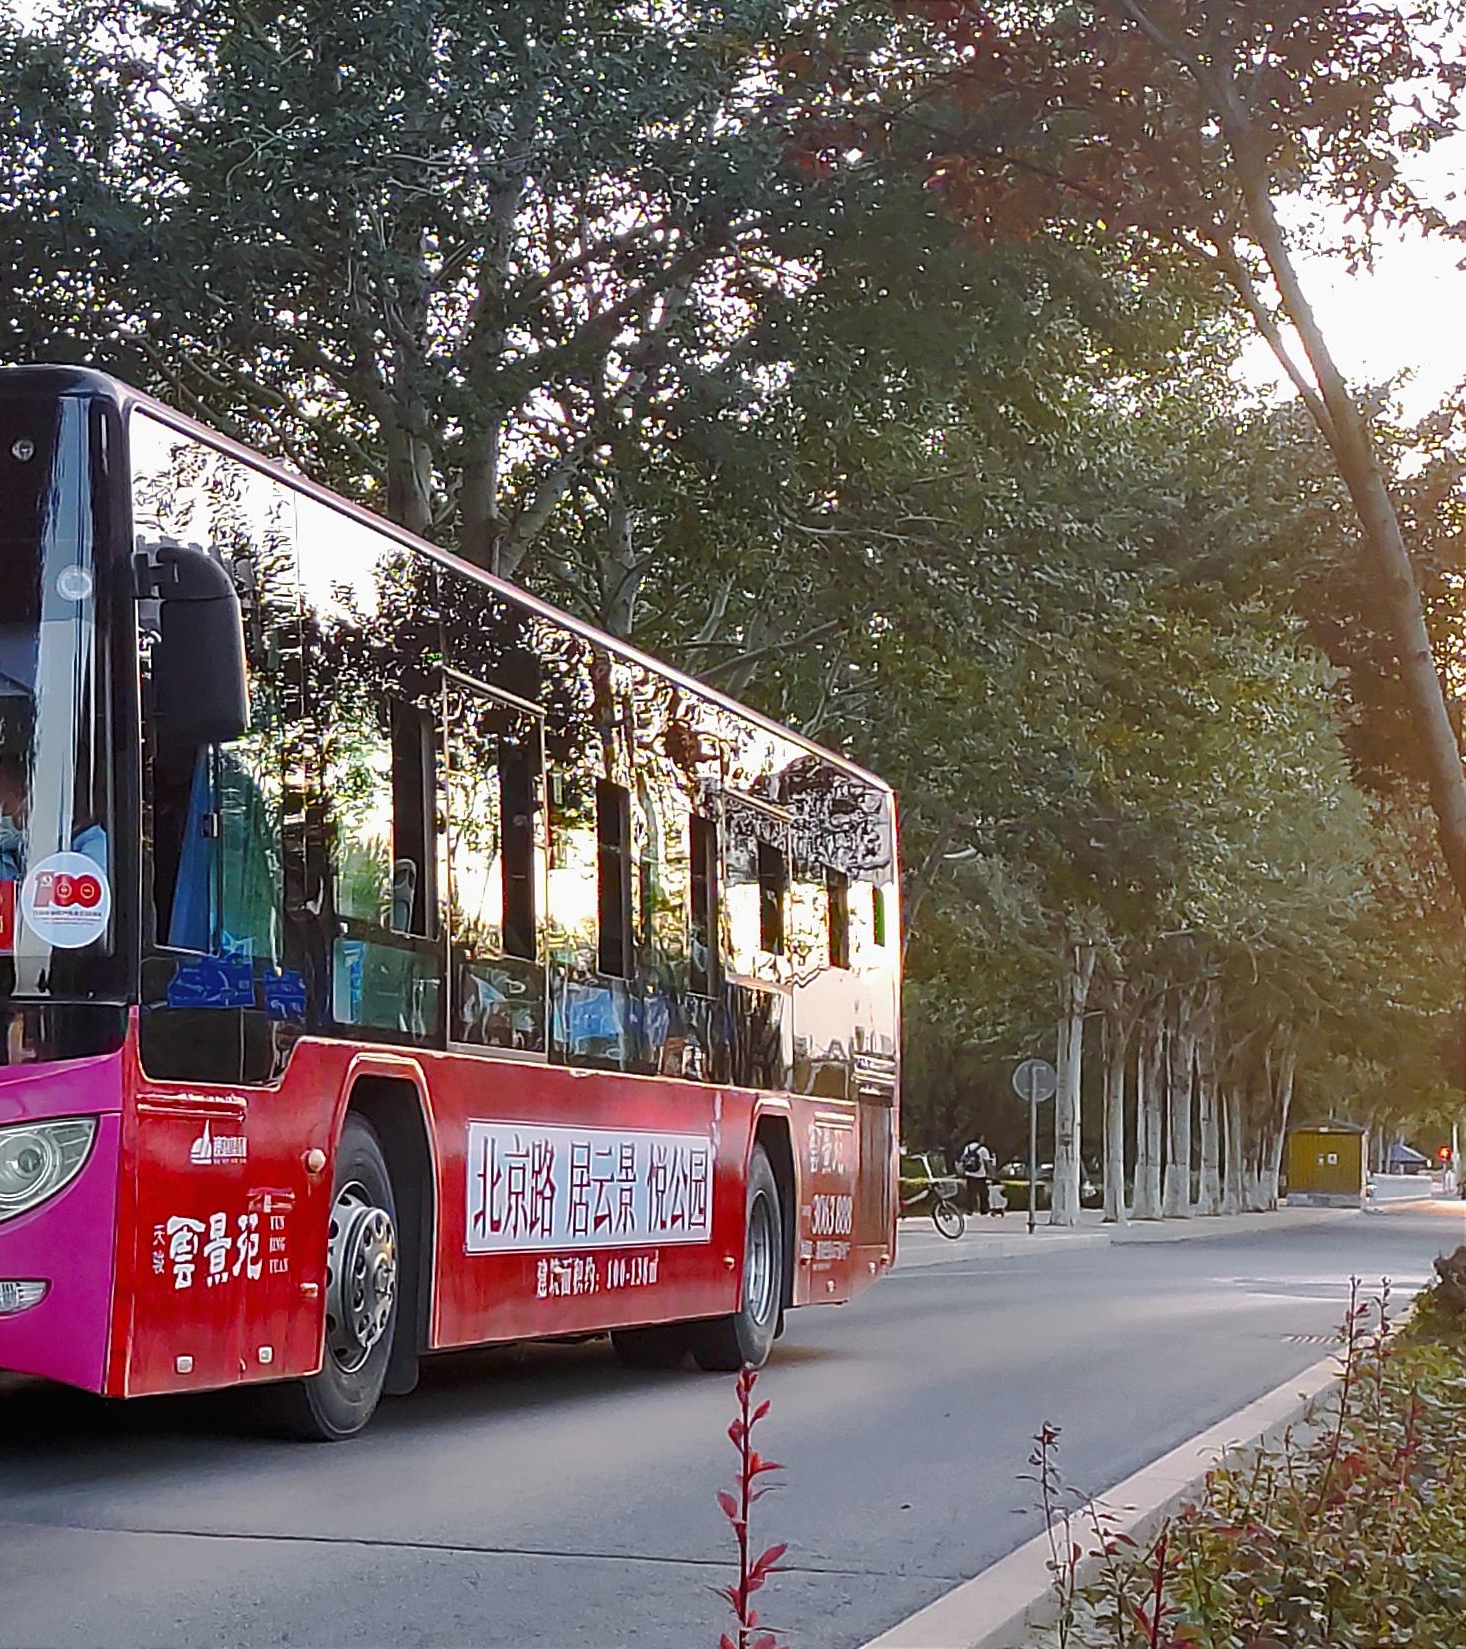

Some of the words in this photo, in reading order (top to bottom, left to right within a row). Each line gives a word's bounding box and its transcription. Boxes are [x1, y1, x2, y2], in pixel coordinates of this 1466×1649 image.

[473, 1134, 556, 1239] 北京路
[566, 1141, 636, 1238] 居云景
[647, 1143, 707, 1233] 悦公园
